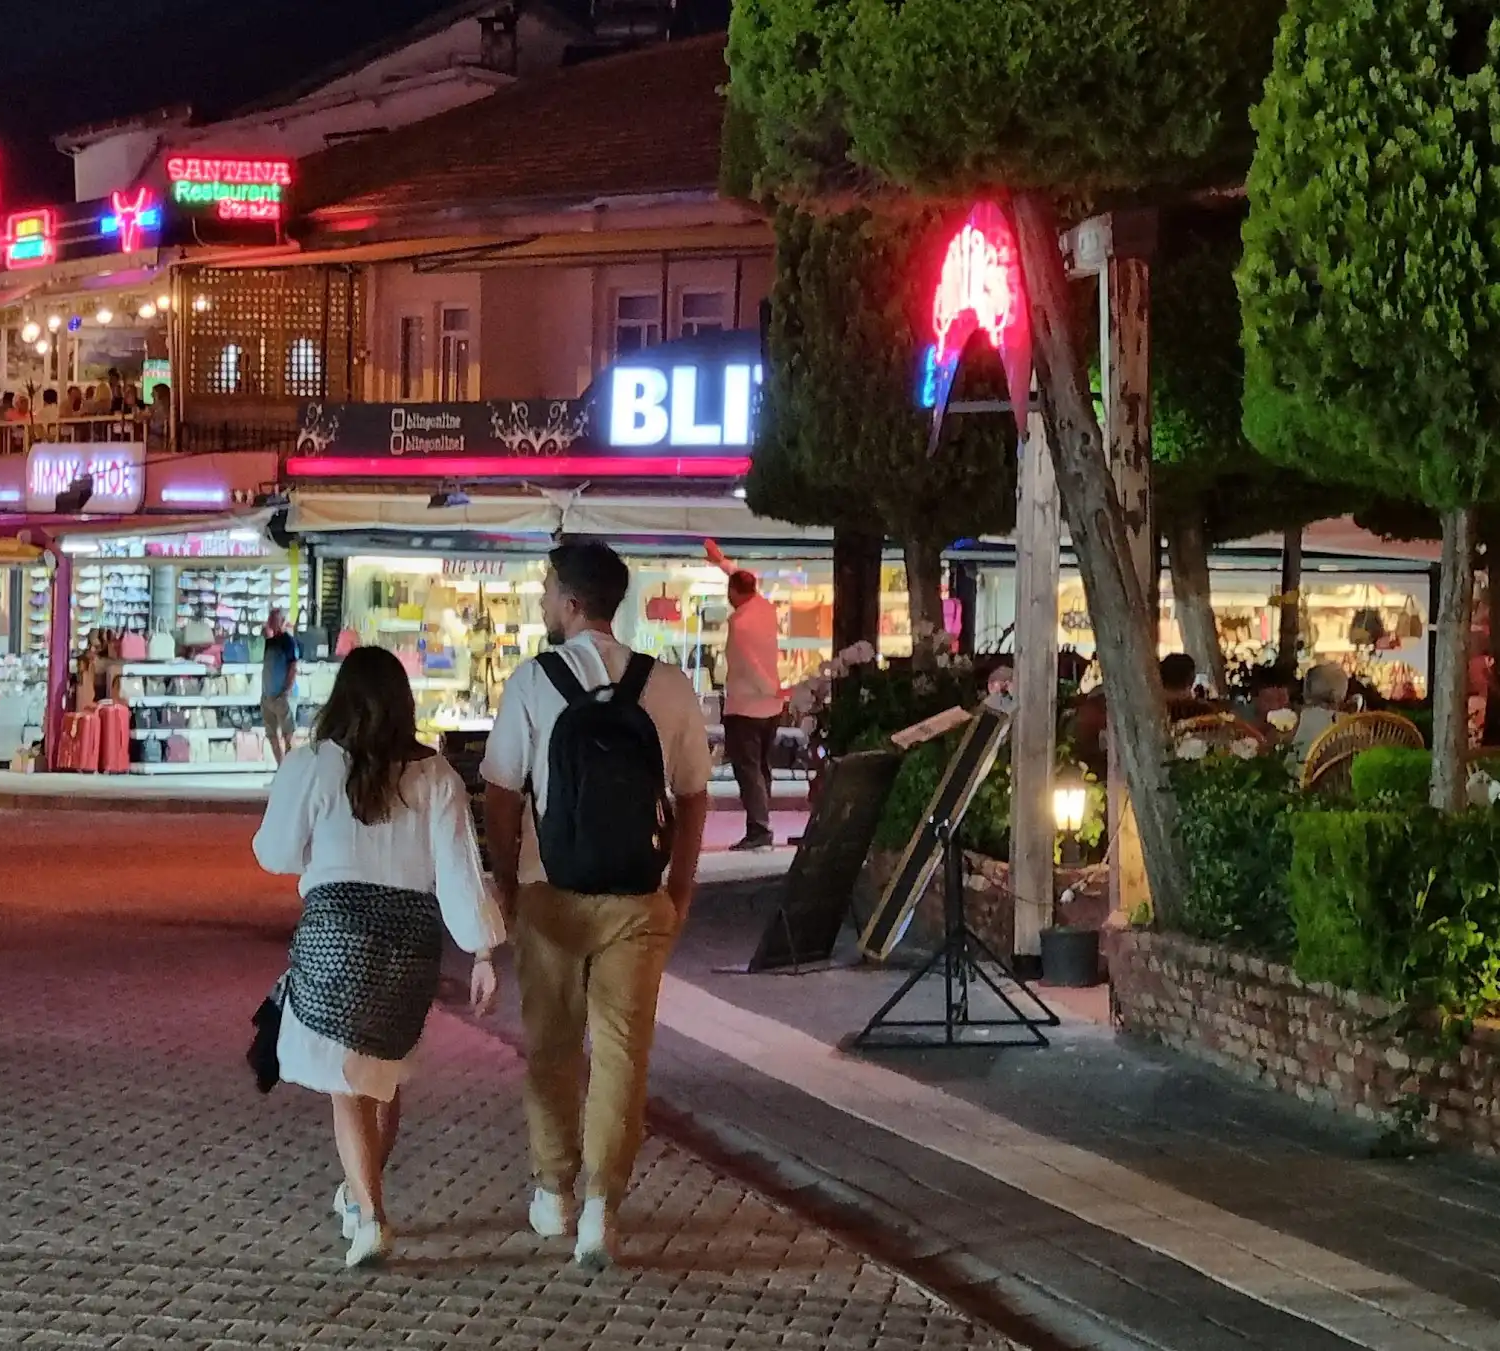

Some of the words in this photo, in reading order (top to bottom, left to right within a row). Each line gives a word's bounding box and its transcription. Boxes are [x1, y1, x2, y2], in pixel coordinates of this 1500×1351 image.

[167, 158, 291, 184] SANTANA
[175, 180, 281, 202] Restaurant
[610, 364, 763, 446] BLI
[406, 412, 461, 431] blingonline
